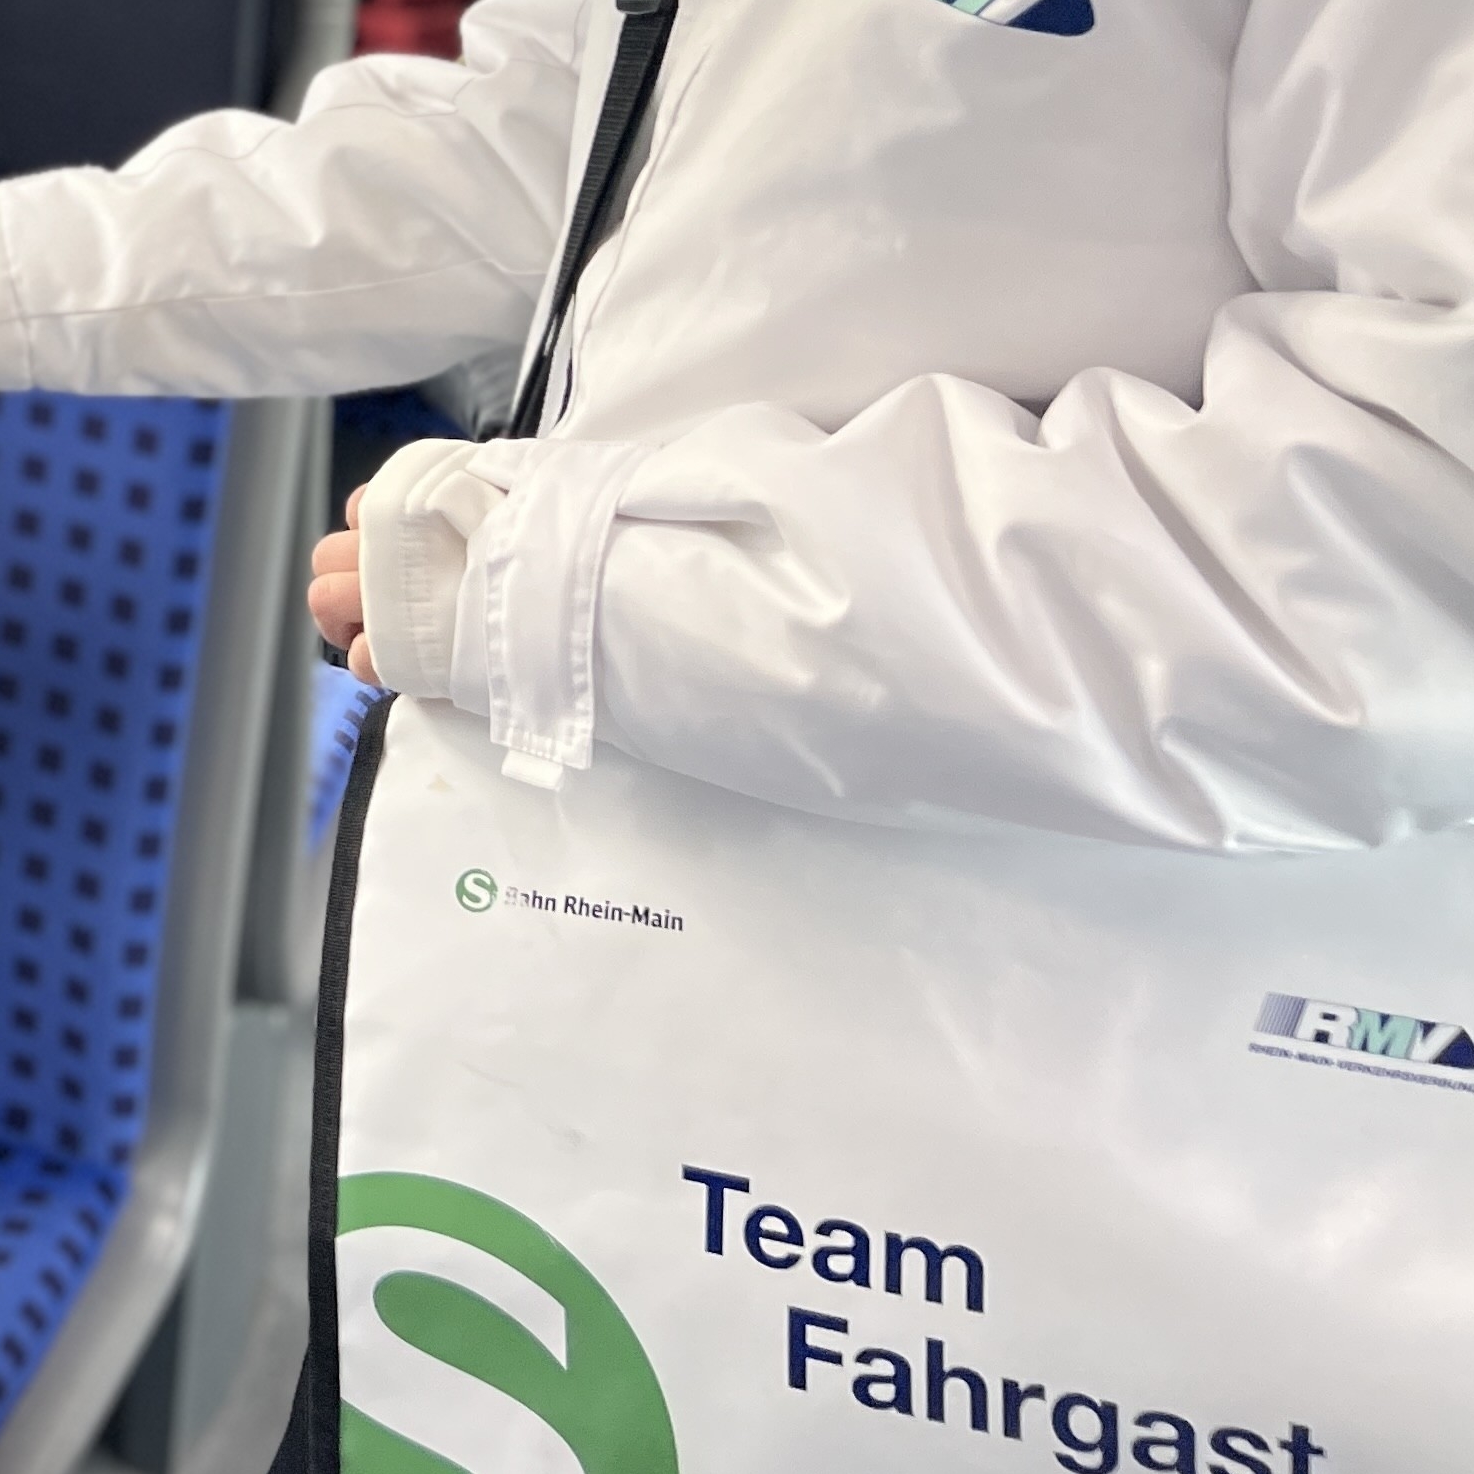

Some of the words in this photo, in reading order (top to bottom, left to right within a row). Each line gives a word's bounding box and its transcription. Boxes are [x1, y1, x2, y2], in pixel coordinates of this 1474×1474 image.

[459, 869, 495, 910] S
[563, 895, 684, 932] Rhein-Main
[1293, 998, 1463, 1064] RMV
[682, 1165, 984, 1313] Team
[788, 1306, 1325, 1474] Fahrgast
